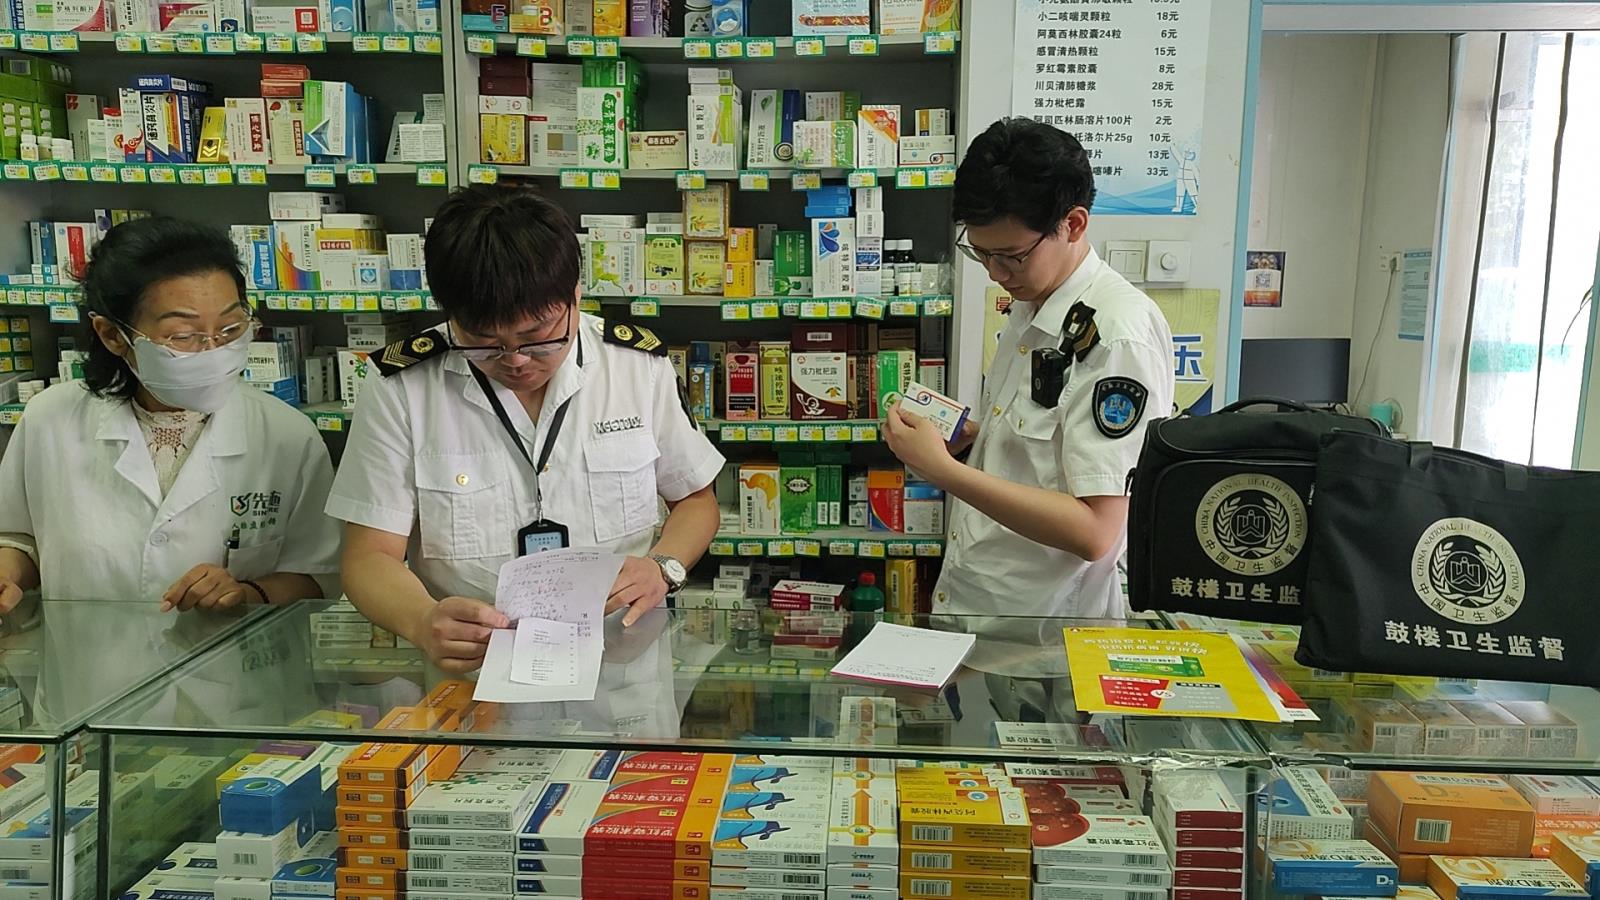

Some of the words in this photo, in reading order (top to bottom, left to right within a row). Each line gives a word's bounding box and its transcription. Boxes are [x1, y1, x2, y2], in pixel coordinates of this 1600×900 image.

[1038, 11, 1111, 22] 小二咳喘灵颗粒
[1156, 11, 1179, 21] 18元
[1037, 29, 1122, 39] 阿莫西林胶囊24粒
[1160, 29, 1178, 39] 6元
[1036, 46, 1099, 57] 感冒清热颗粒
[1154, 47, 1177, 56] 15元
[1035, 64, 1098, 74] 罗红霉素胶囊
[1158, 64, 1176, 74] 8元
[1034, 81, 1097, 91] 川贝清肺糖浆
[1151, 81, 1174, 91] 28元
[1034, 98, 1086, 108] 强力枇杷露
[1151, 99, 1173, 108] 15元
[1155, 116, 1172, 125] 2元
[1149, 133, 1171, 143] 10元
[1148, 150, 1170, 160] 13元
[1146, 167, 1169, 177] 33元
[800, 366, 838, 376] 强力枇杷露
[903, 362, 912, 393] 咳特灵胶
[1416, 549, 1428, 577] CHINA
[1424, 522, 1456, 546] NATIONAL
[1205, 538, 1299, 574] 中国卫生监督
[1170, 576, 1300, 606] 鼓楼卫生监
[1418, 582, 1520, 622] 中国卫生监督
[1384, 620, 1565, 661] 鼓楼卫生监督
[1154, 690, 1174, 698] VS
[622, 762, 696, 772] 罗红霉素胶囊
[608, 793, 686, 803] 罗红霉素胶囊
[591, 826, 673, 837] 罗红霉素胶囊
